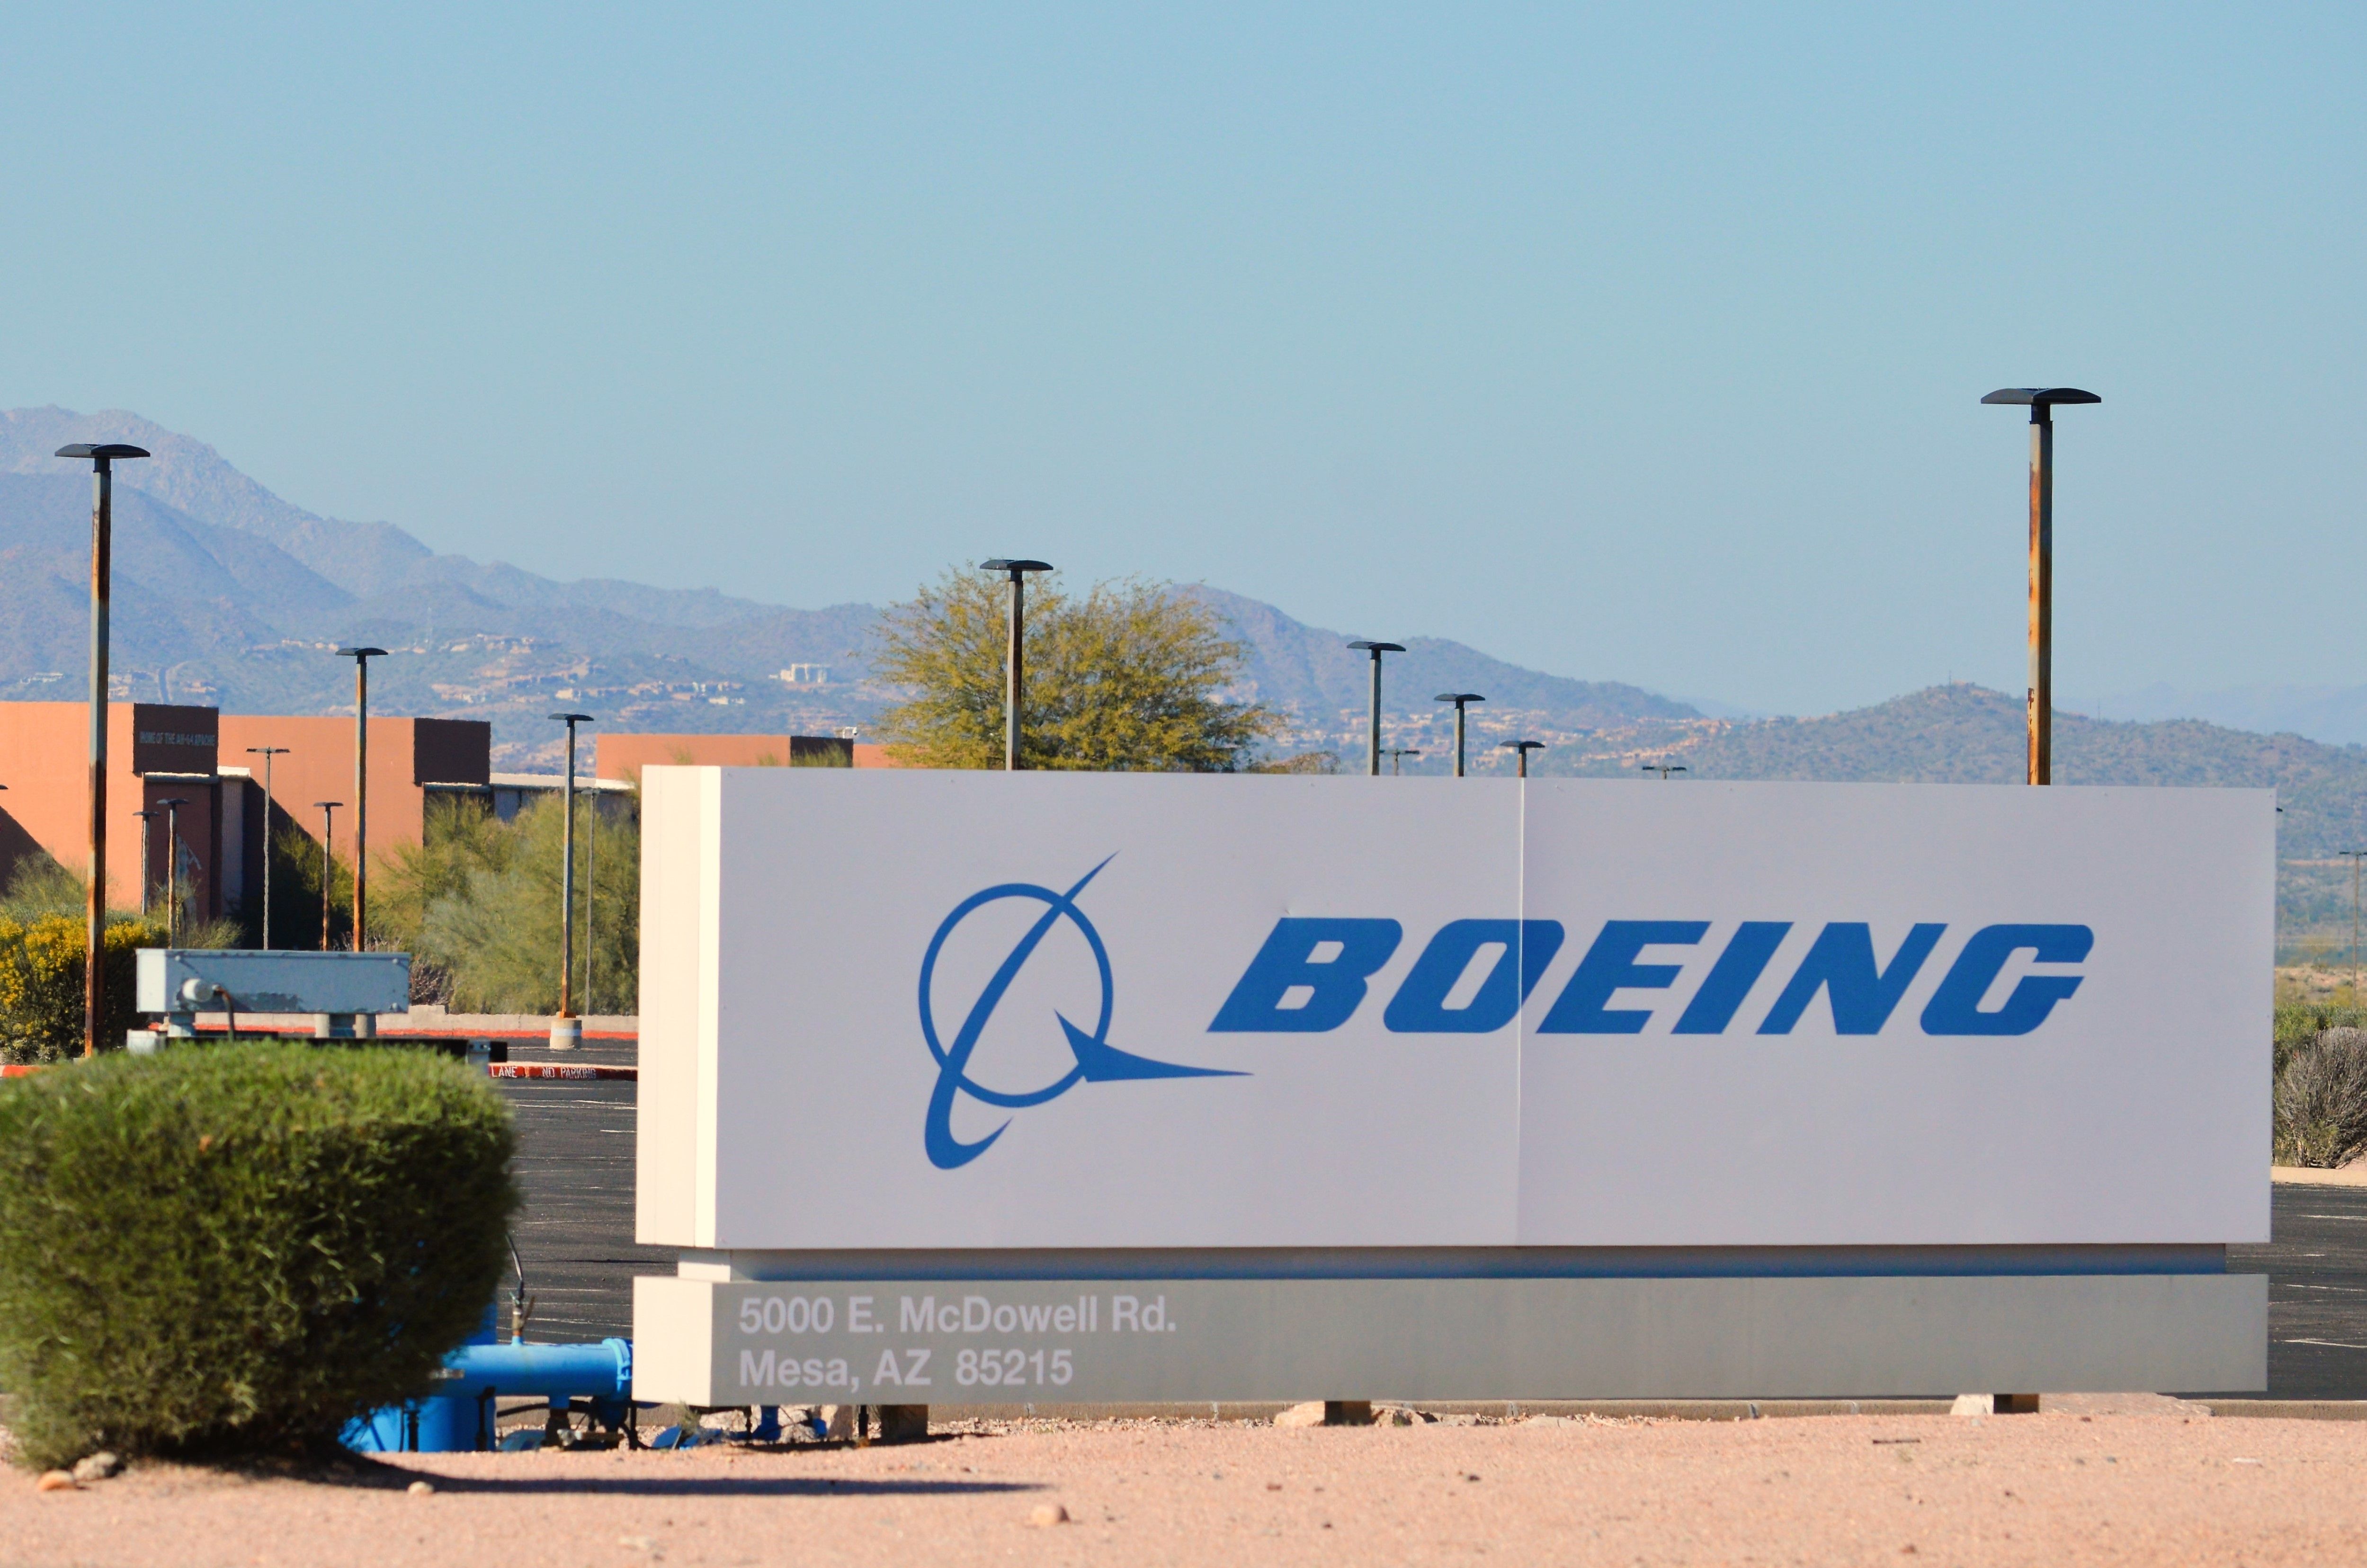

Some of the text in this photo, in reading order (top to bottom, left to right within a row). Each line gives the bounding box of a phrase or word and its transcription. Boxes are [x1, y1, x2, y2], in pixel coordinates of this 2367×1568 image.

[1207, 918, 2094, 1036] BOEING
[491, 1066, 597, 1079] LANE NO PARKING
[739, 1295, 1177, 1334] 5000 E. McDowell Rd.
[740, 1348, 1073, 1393] Mesa, AZ 85215
